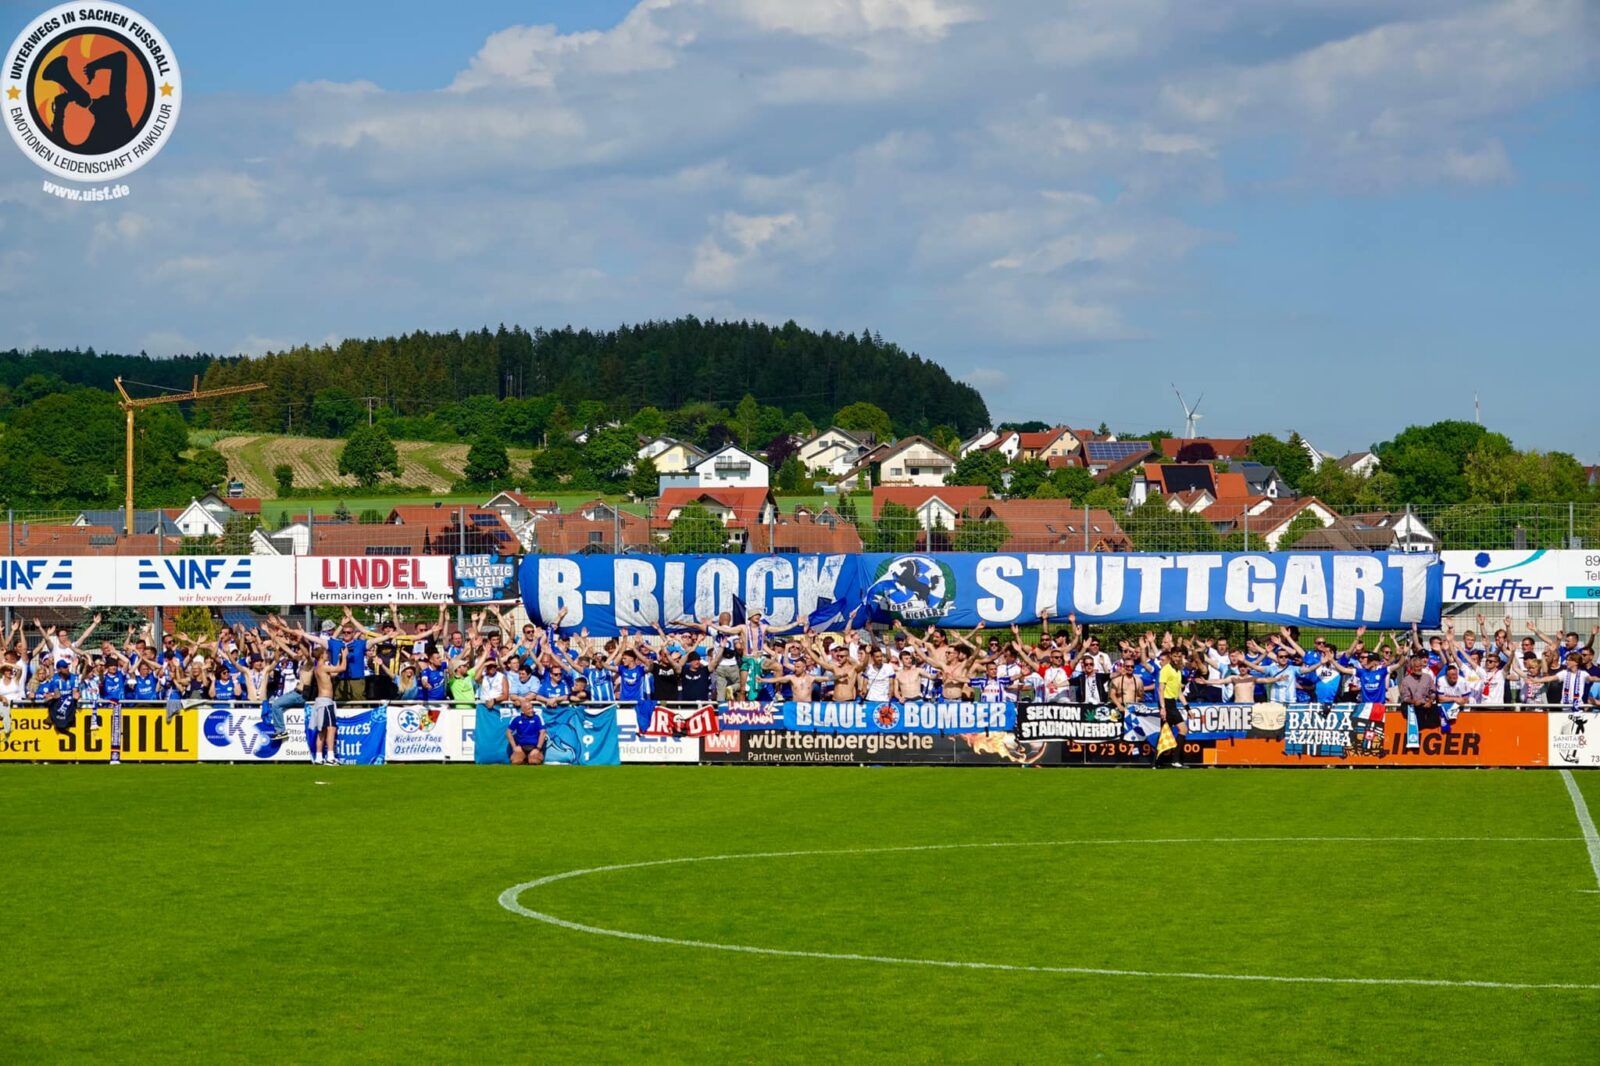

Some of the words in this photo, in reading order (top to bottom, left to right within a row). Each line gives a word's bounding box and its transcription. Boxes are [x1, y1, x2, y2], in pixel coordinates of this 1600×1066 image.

[458, 556, 490, 568] BLUE
[321, 558, 428, 589] LINDEL
[456, 566, 513, 577] FANATIC
[475, 576, 503, 587] SEIT
[1443, 573, 1553, 602] Kieffer
[196, 593, 232, 603] bewegen
[235, 592, 272, 602] Zukunft
[311, 591, 383, 602] Hermaringen
[397, 591, 418, 600] Inh.
[461, 587, 491, 599] 2009
[538, 555, 847, 628] B-BLOCK
[975, 553, 1439, 623] STUTTGART
[56, 594, 92, 604] Zukunft
[905, 608, 945, 620] KICKERS
[796, 702, 867, 728] BLAUE
[903, 701, 1007, 729] BOMBER
[1026, 705, 1082, 721] SEKTION
[1205, 705, 1253, 731] CARE
[1288, 712, 1354, 731] BANDA
[1021, 721, 1123, 739] STADIONVERBOT
[748, 730, 934, 754] württembergische
[1287, 730, 1353, 747] AZZURRA
[394, 744, 442, 755] Ostfildern
[747, 751, 782, 761] Partner
[784, 753, 801, 761] von
[804, 751, 854, 761] Wüstenrot
